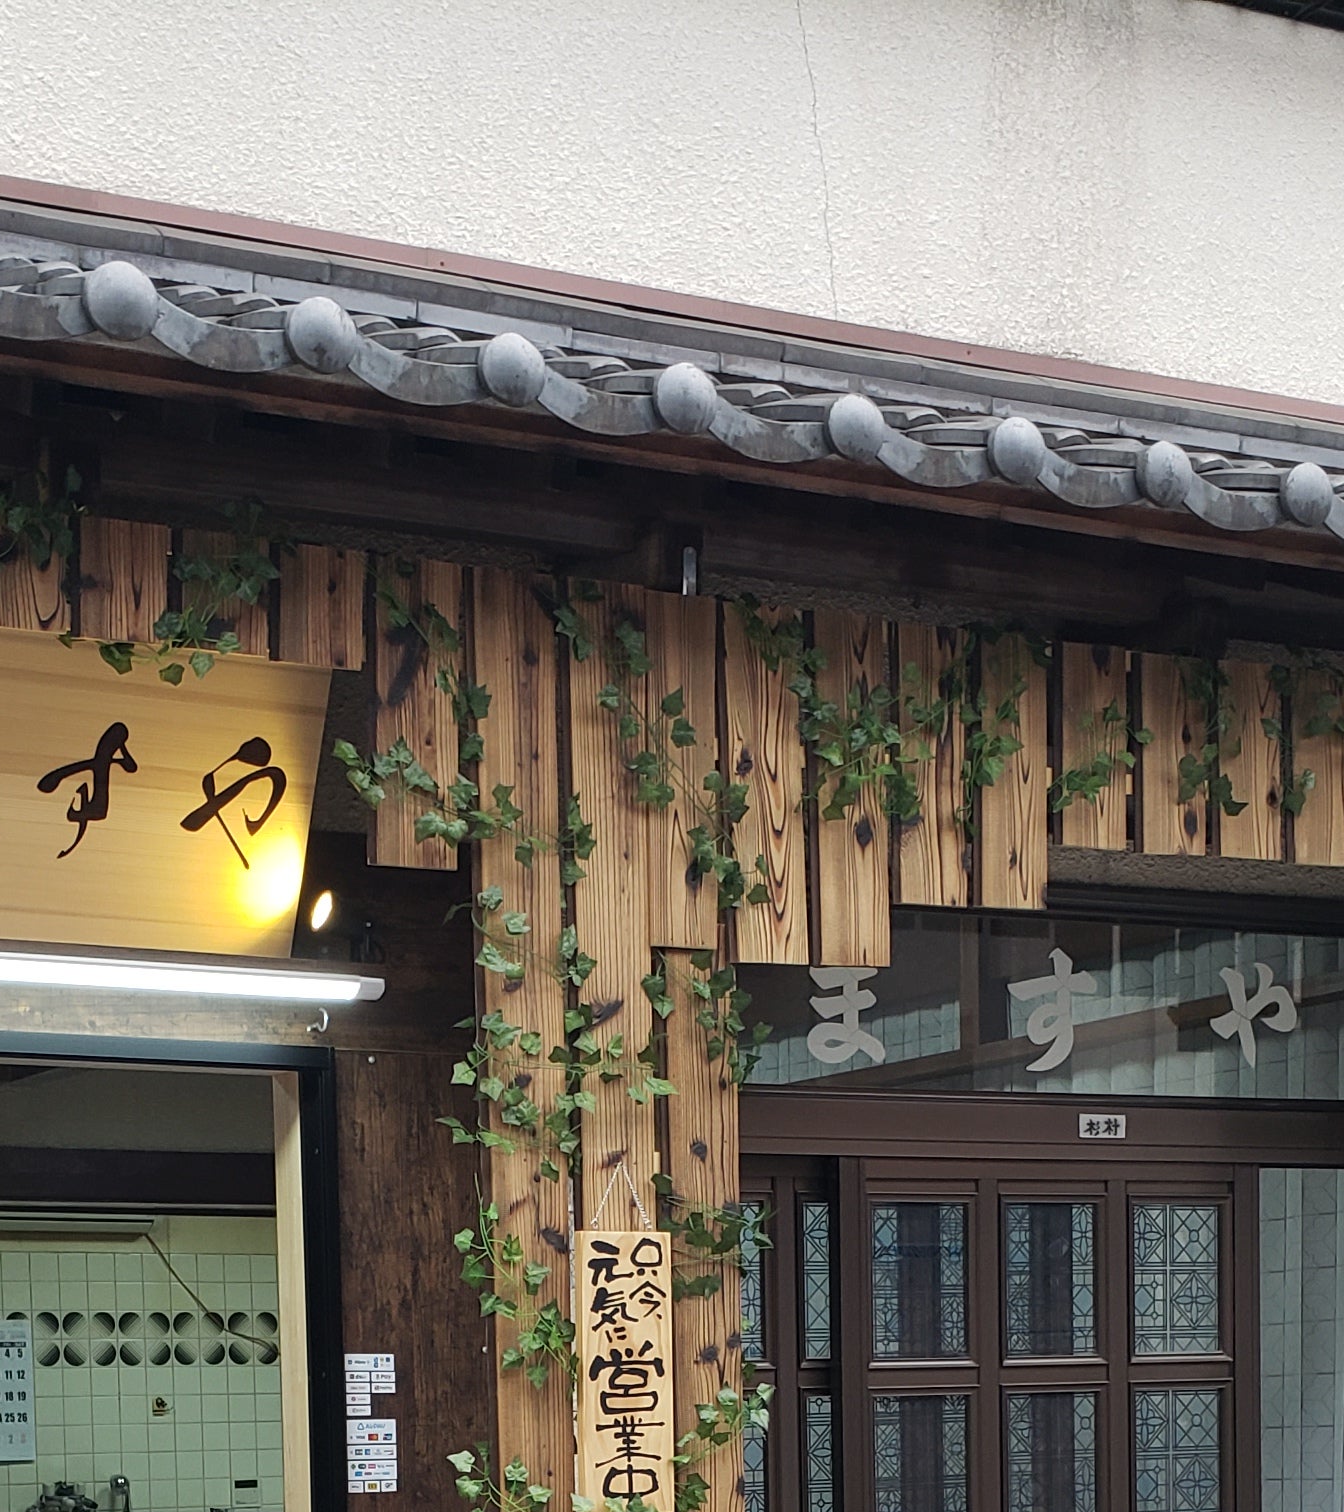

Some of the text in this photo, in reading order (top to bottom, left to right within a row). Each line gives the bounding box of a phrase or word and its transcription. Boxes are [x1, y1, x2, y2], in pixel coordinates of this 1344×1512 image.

[807, 948, 1299, 1072] ますや
[1084, 1118, 1120, 1137] 杉村
